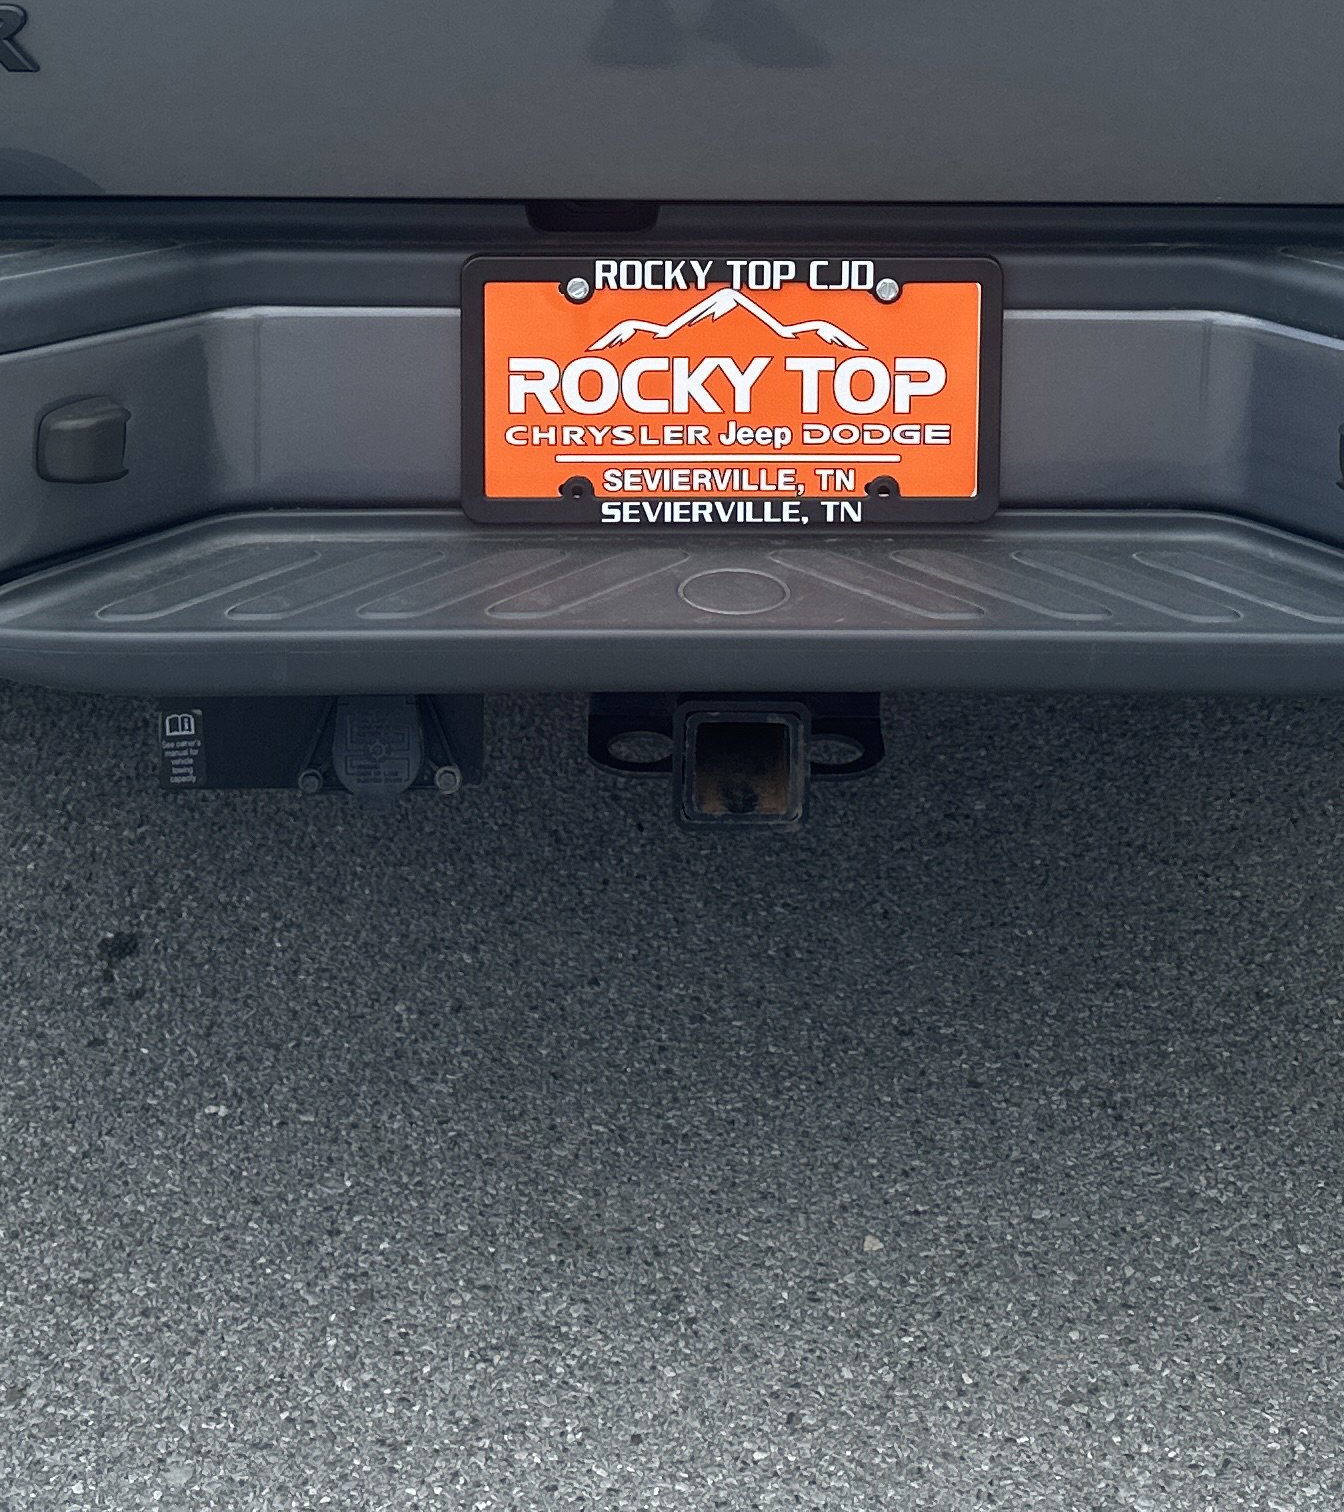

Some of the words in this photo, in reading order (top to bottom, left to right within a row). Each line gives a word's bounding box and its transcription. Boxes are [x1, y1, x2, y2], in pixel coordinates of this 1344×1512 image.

[595, 260, 714, 290] ROCKY
[726, 260, 796, 290] TOP
[809, 261, 875, 290] CJD
[508, 356, 774, 415] ROCKY
[785, 356, 947, 415] TOP
[505, 425, 711, 446] CHRYSLER
[719, 421, 792, 448] Jeep
[802, 424, 952, 445] DODGE
[603, 469, 805, 496] SEVIERVILLE,
[815, 469, 855, 492] TN
[601, 502, 809, 525] SEVIERVILLE,
[820, 502, 862, 523] TN
